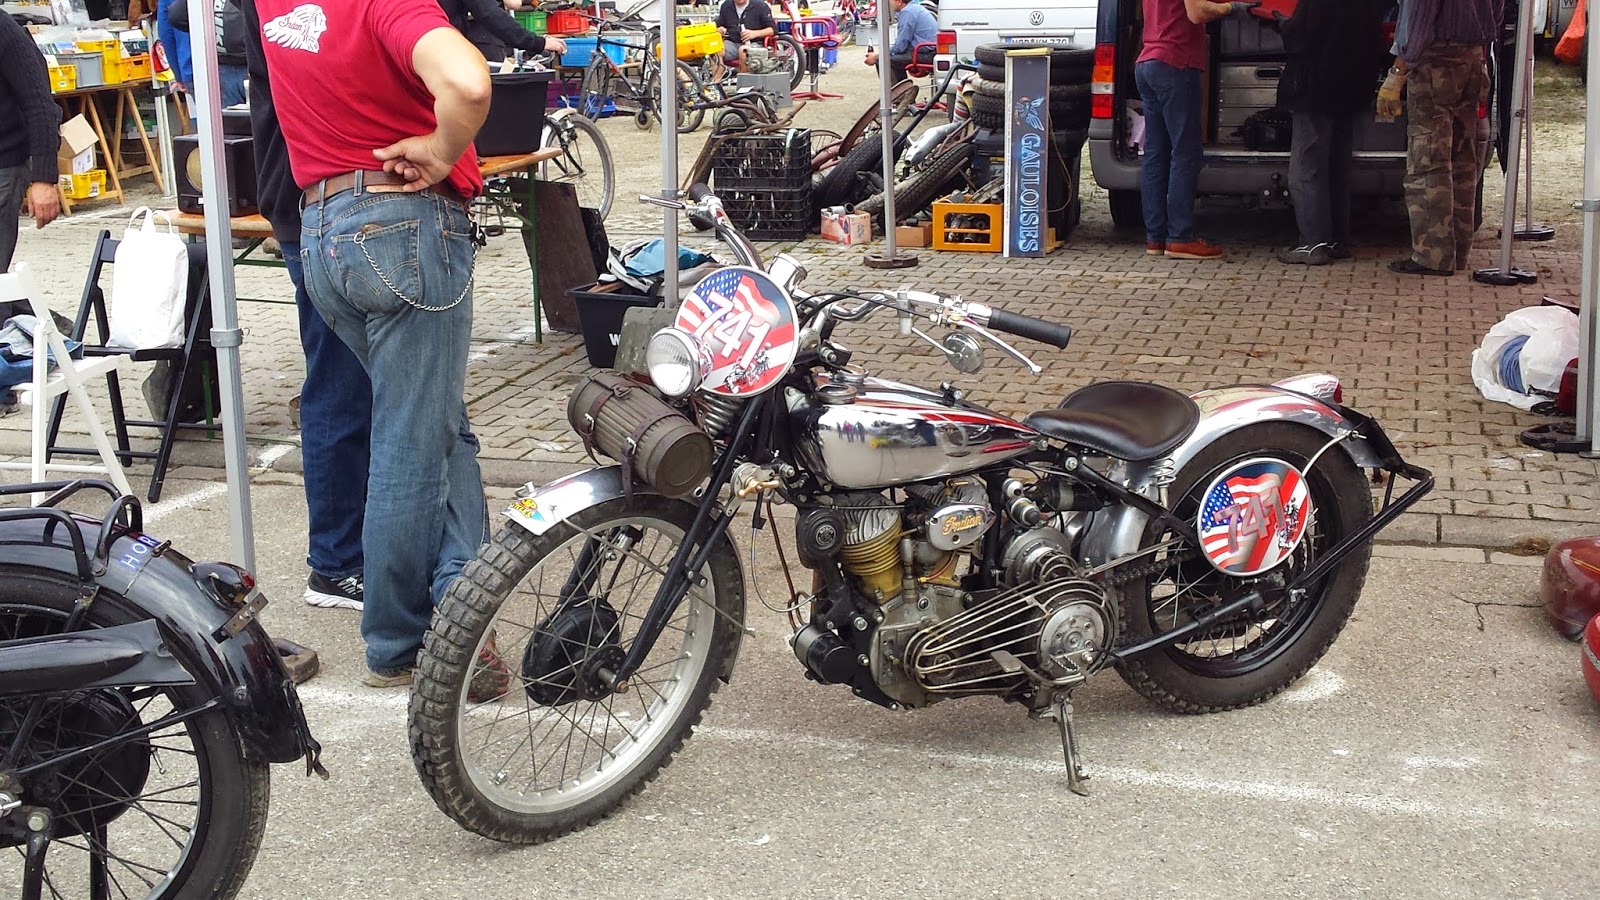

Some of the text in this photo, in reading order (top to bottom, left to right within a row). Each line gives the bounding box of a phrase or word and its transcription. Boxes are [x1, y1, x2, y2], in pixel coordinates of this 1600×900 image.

[1018, 132, 1042, 252] GAULOISES
[693, 290, 772, 371] 741
[942, 512, 983, 535] Indian
[1213, 485, 1287, 555] 741
